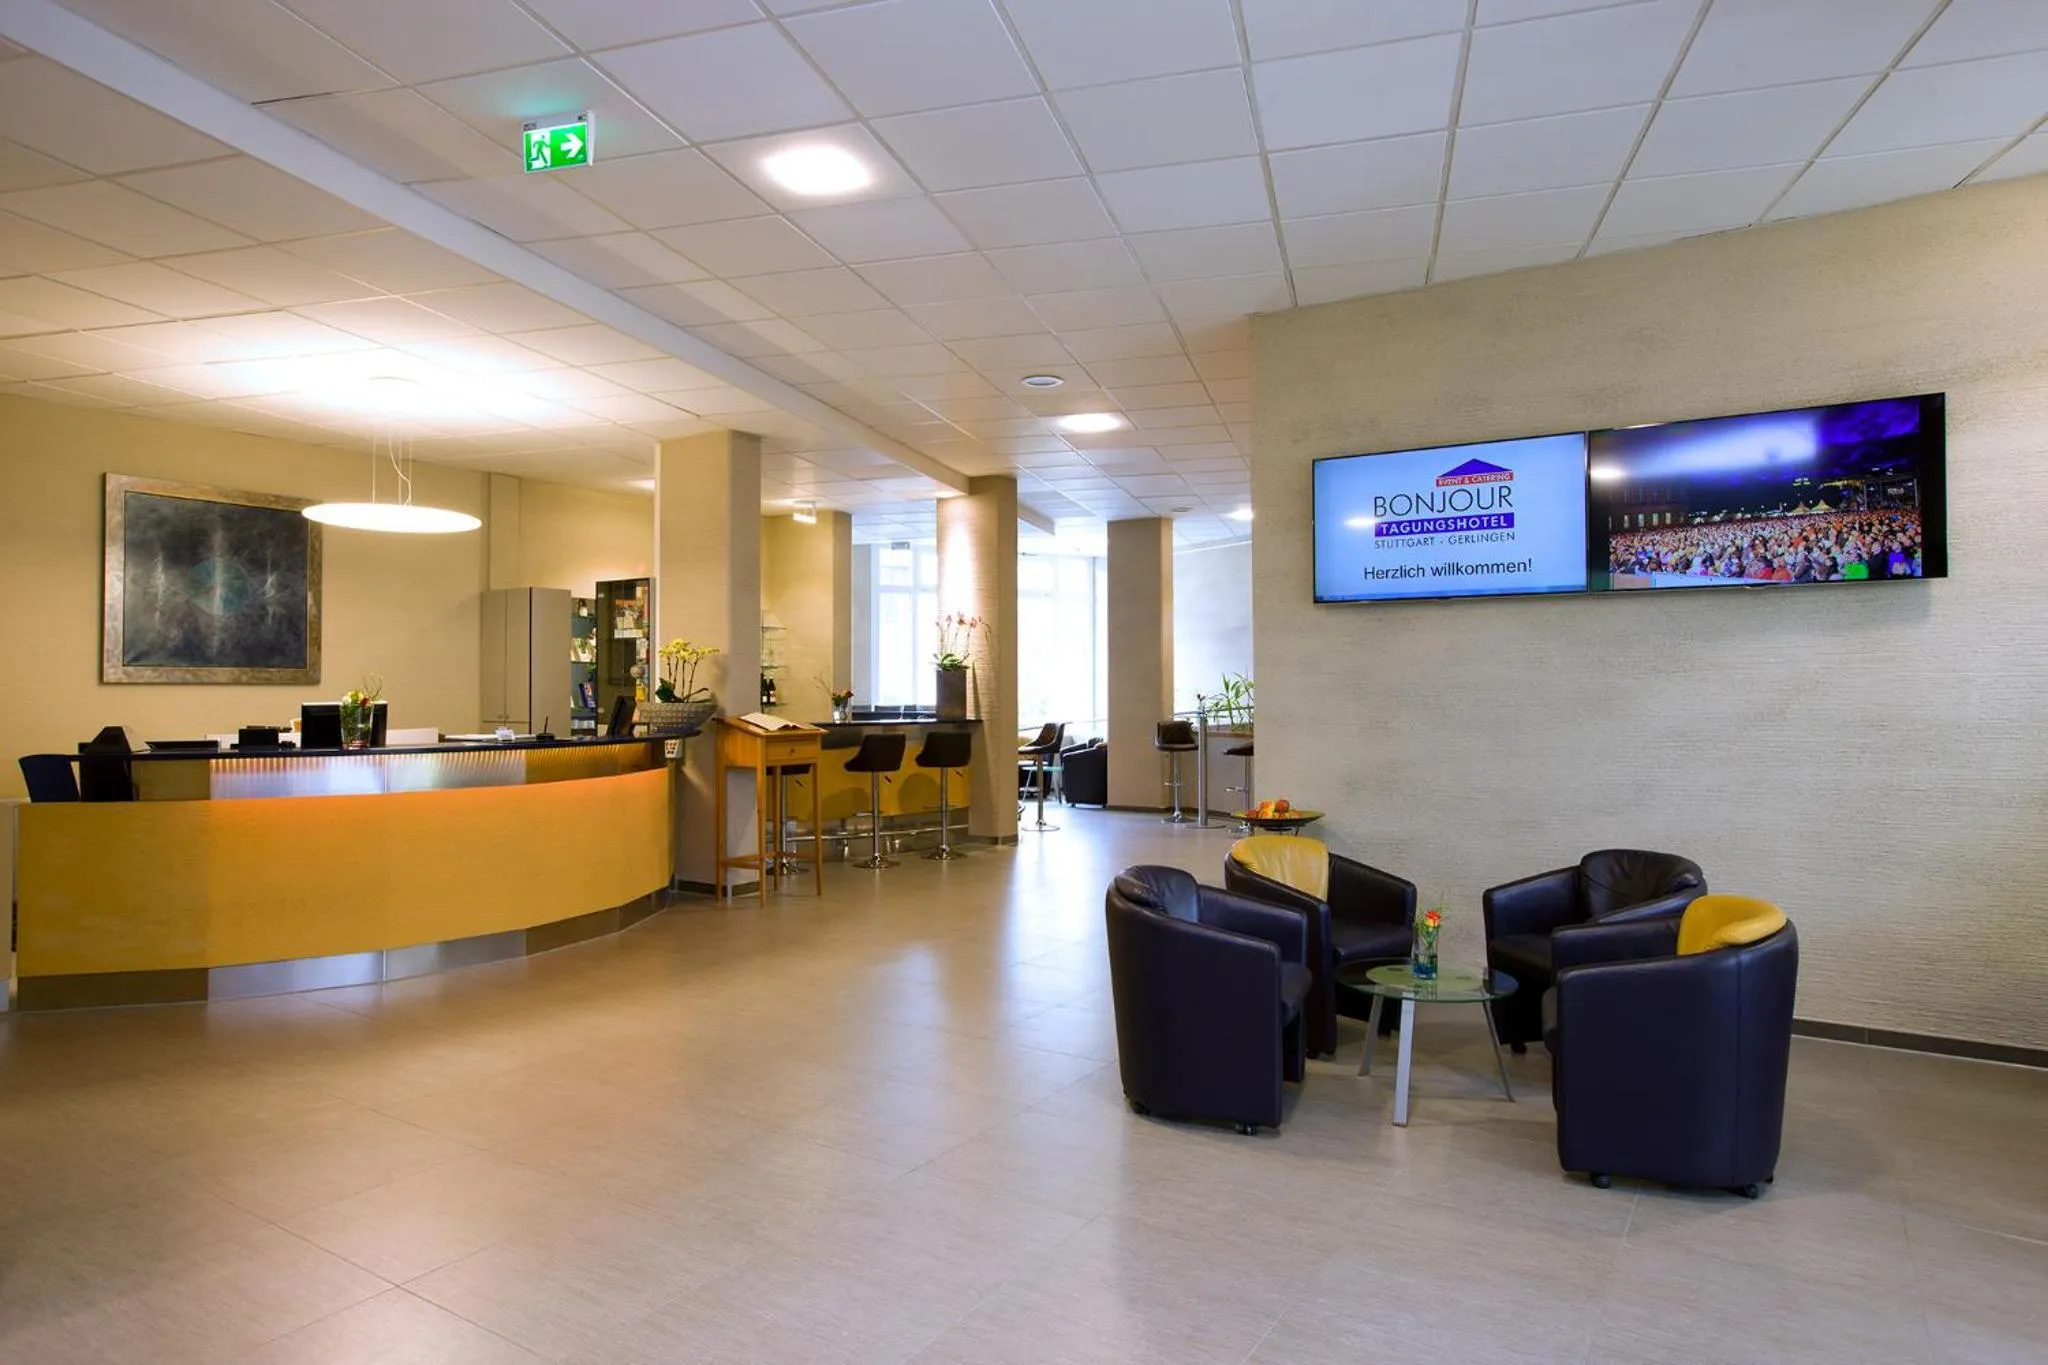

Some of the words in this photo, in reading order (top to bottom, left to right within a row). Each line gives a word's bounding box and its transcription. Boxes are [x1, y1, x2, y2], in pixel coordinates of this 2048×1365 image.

[1438, 477, 1462, 486] EVENT
[1471, 473, 1511, 483] CATERING
[1374, 485, 1513, 518] BONJOUR
[1380, 515, 1508, 535] TAGUNGSHOTEL
[1374, 537, 1435, 549] STUTTGART
[1448, 531, 1515, 545] GERLINGEN
[1364, 564, 1425, 580] Herzlich
[1430, 558, 1532, 577] willkommen!
